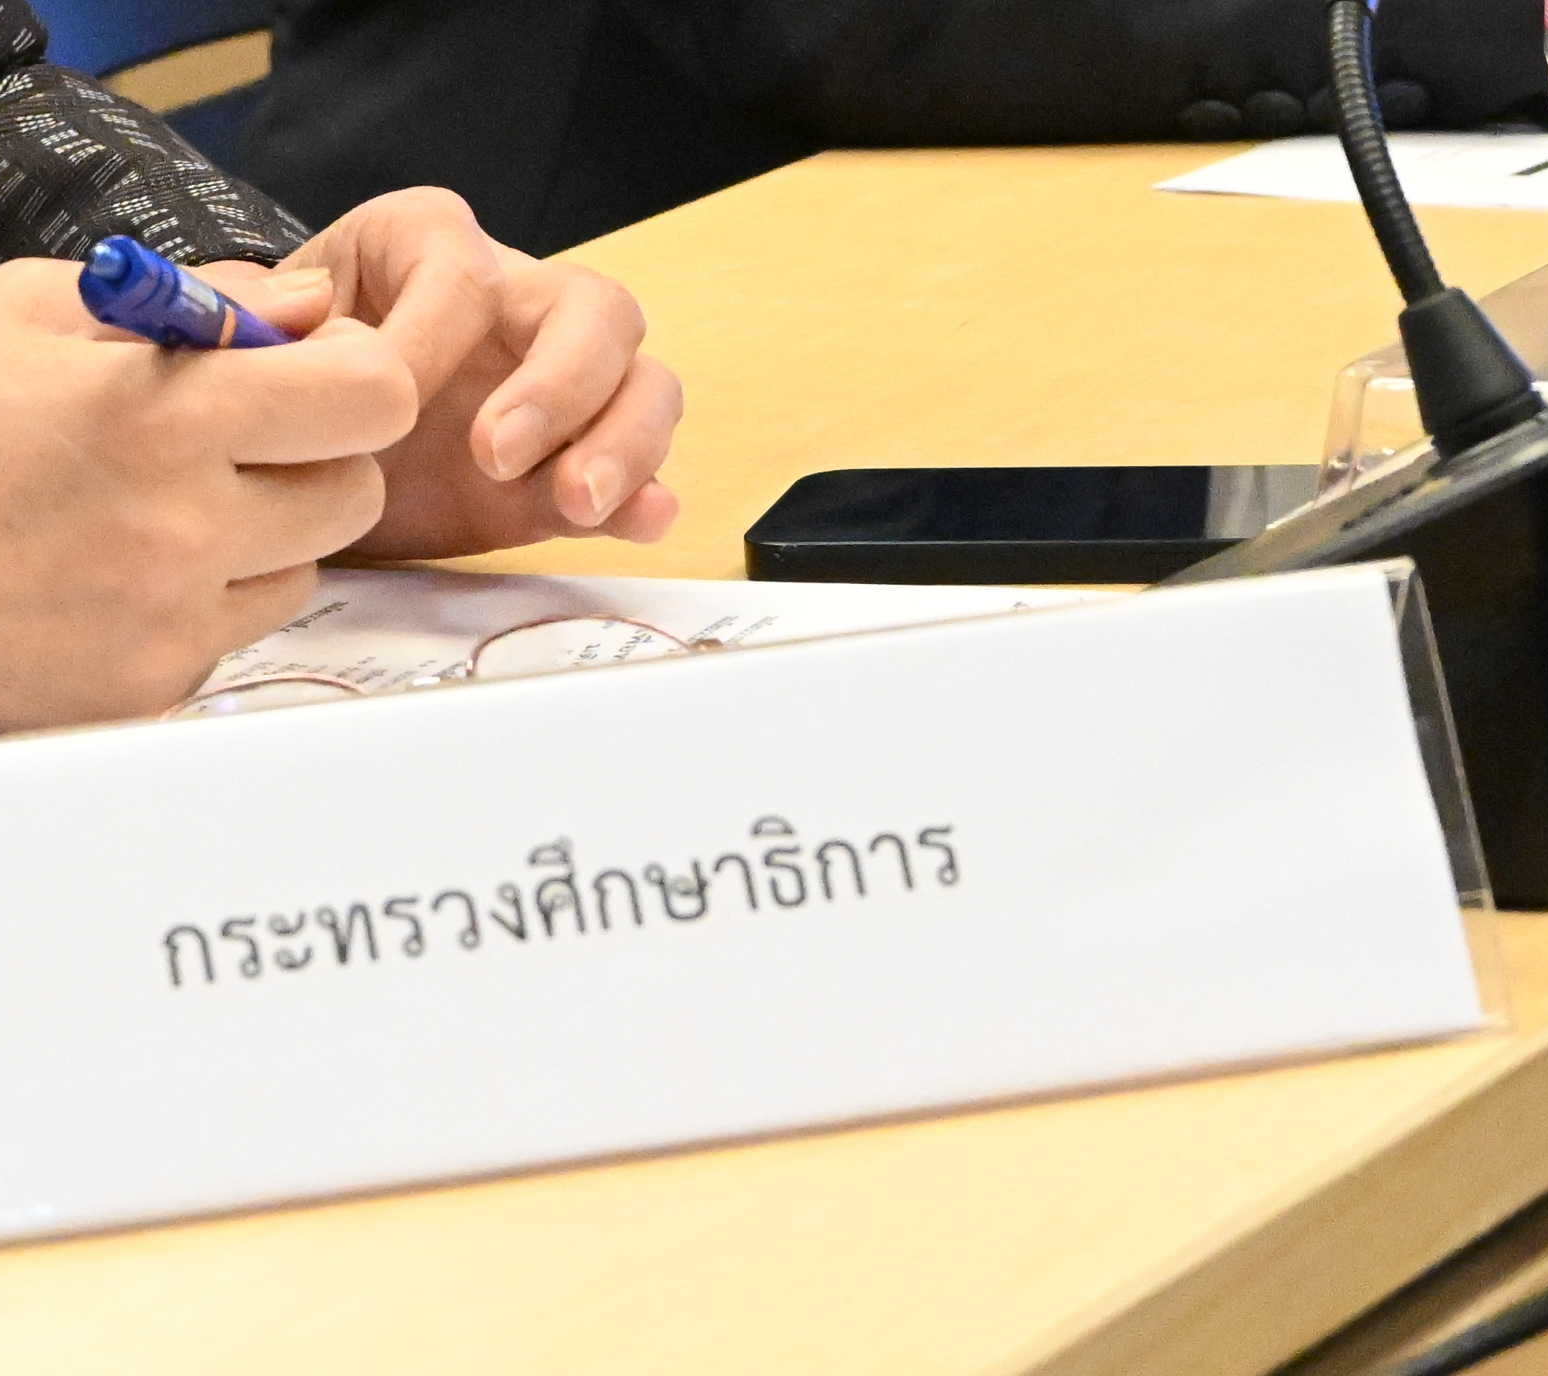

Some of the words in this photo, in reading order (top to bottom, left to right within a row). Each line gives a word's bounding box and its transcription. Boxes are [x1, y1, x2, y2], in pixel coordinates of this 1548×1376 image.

[161, 815, 961, 988] กระทรวงศึกษาธิการ
